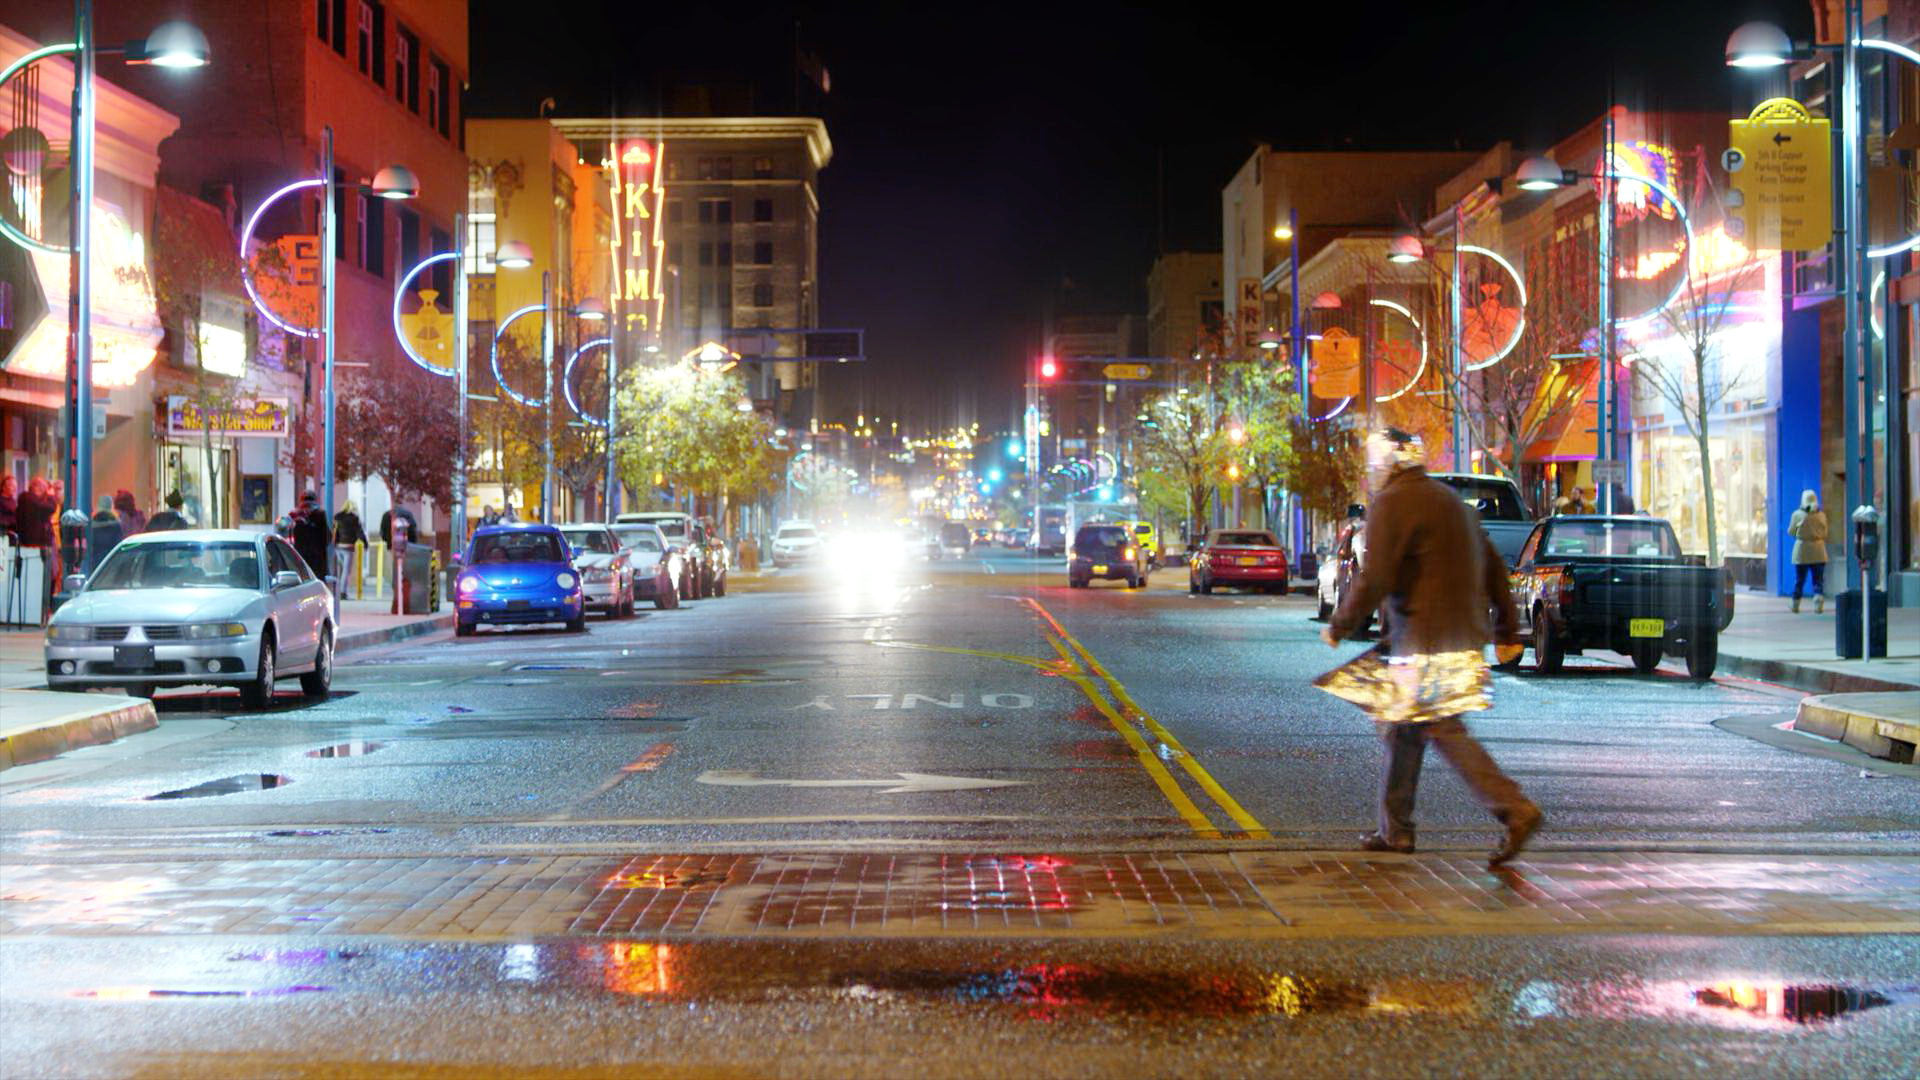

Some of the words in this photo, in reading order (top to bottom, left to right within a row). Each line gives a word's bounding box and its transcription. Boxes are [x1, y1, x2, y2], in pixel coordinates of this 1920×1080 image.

[1727, 151, 1741, 170] P
[1754, 162, 1781, 174] Parking
[1782, 162, 1807, 173] Garage
[786, 693, 1035, 711] ONLY
